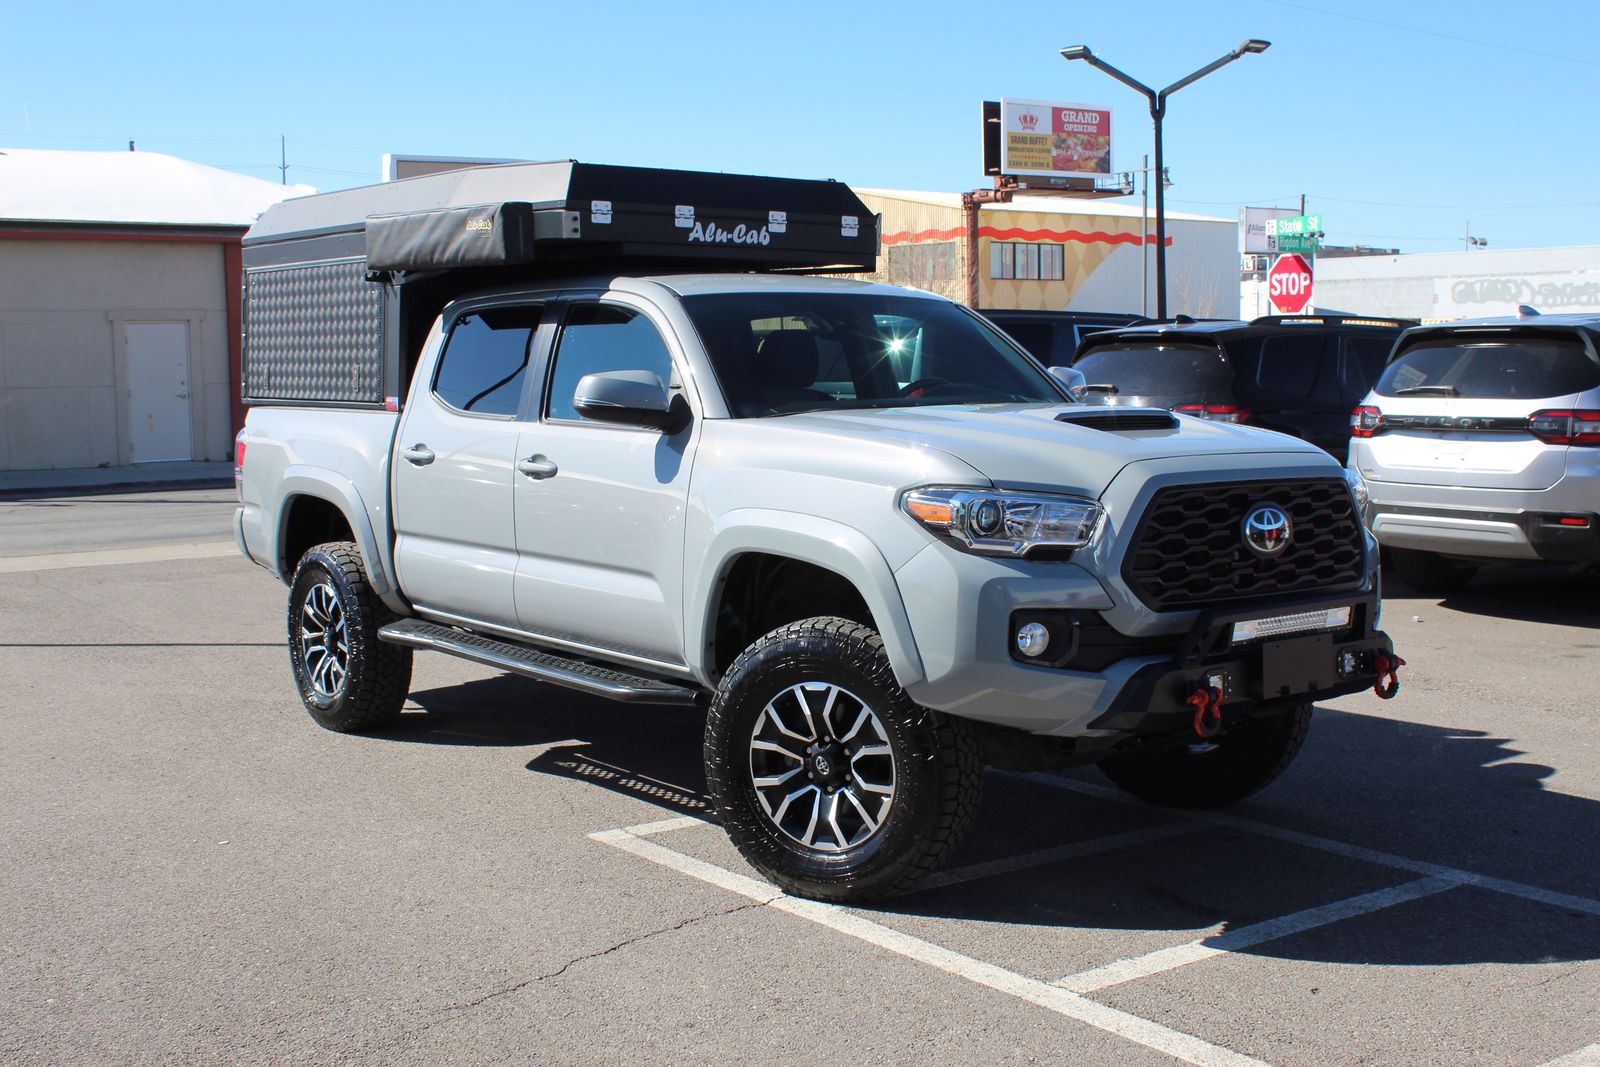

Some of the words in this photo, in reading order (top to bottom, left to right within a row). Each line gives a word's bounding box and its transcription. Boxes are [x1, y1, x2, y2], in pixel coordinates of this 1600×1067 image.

[1061, 111, 1099, 124] GRAND
[1064, 124, 1097, 133] OPENING
[1279, 218, 1303, 233] State
[1307, 215, 1319, 230] St
[688, 221, 770, 246] Alu-Cab
[1271, 272, 1310, 296] STOP
